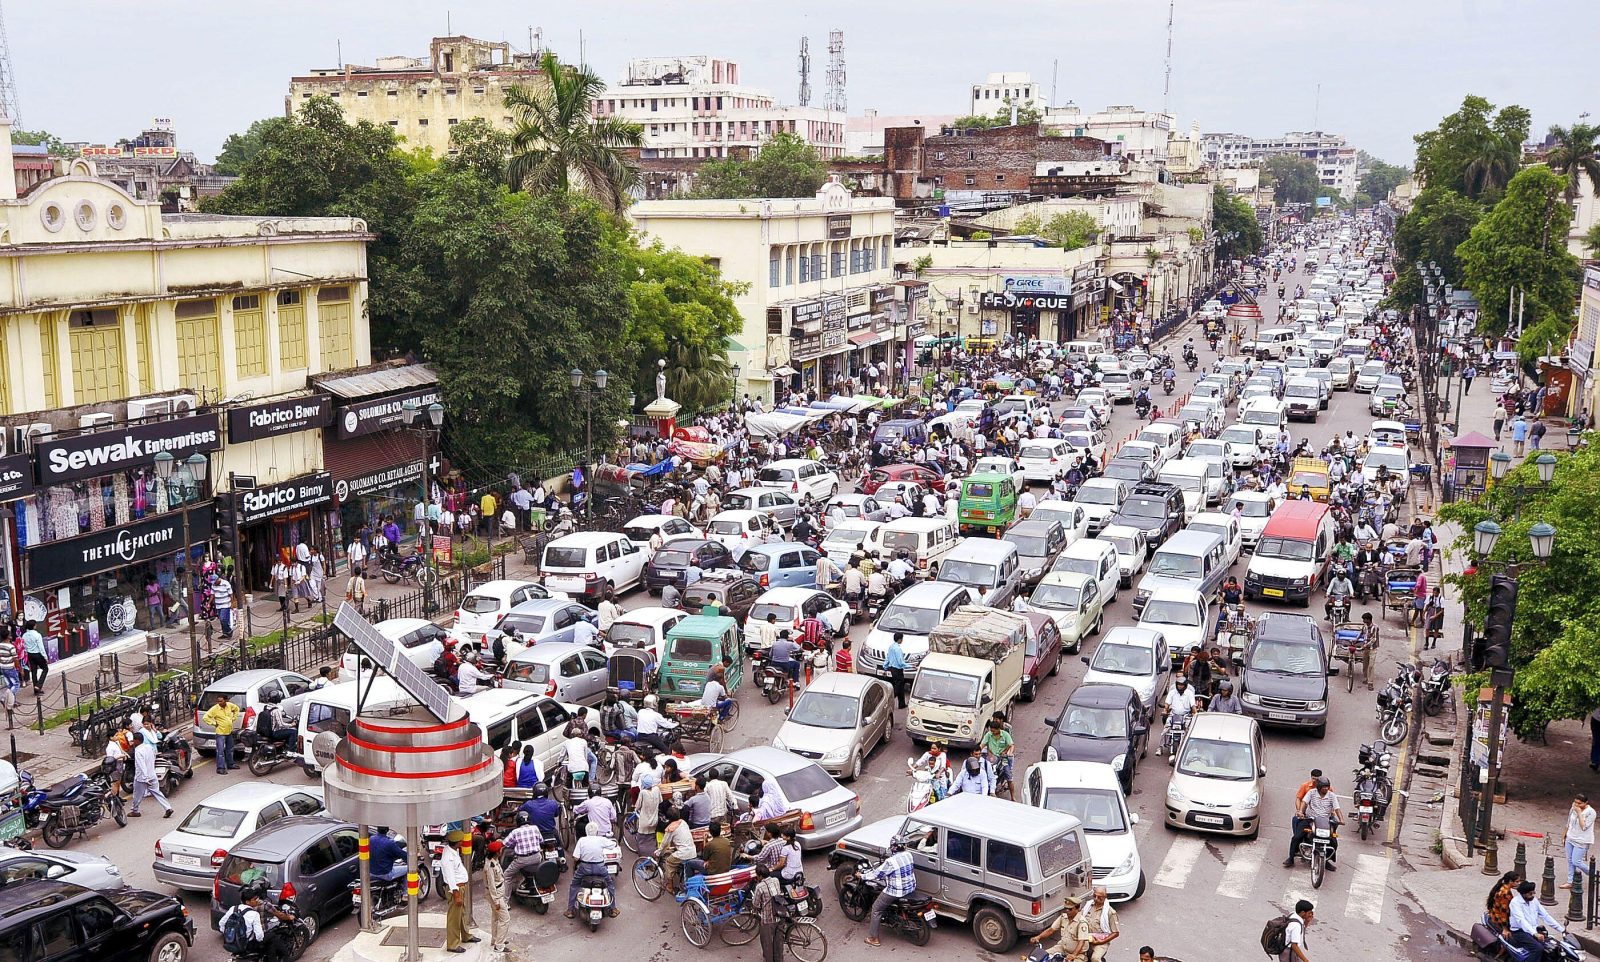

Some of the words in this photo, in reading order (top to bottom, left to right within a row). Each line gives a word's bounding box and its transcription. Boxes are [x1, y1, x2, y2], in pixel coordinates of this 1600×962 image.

[359, 404, 386, 420] SOLOMAN
[387, 404, 392, 413] &
[50, 436, 144, 473] Sewak
[144, 430, 216, 454] Enterprises
[3, 472, 10, 480] &
[350, 475, 374, 491] SOLOMAN
[374, 475, 378, 485] &
[387, 468, 404, 480] RETAIL
[300, 484, 323, 498] Binny
[82, 546, 102, 562] THE
[104, 540, 132, 558] TIME
[132, 527, 174, 552] FACTORY
[315, 750, 334, 759] SUMO
